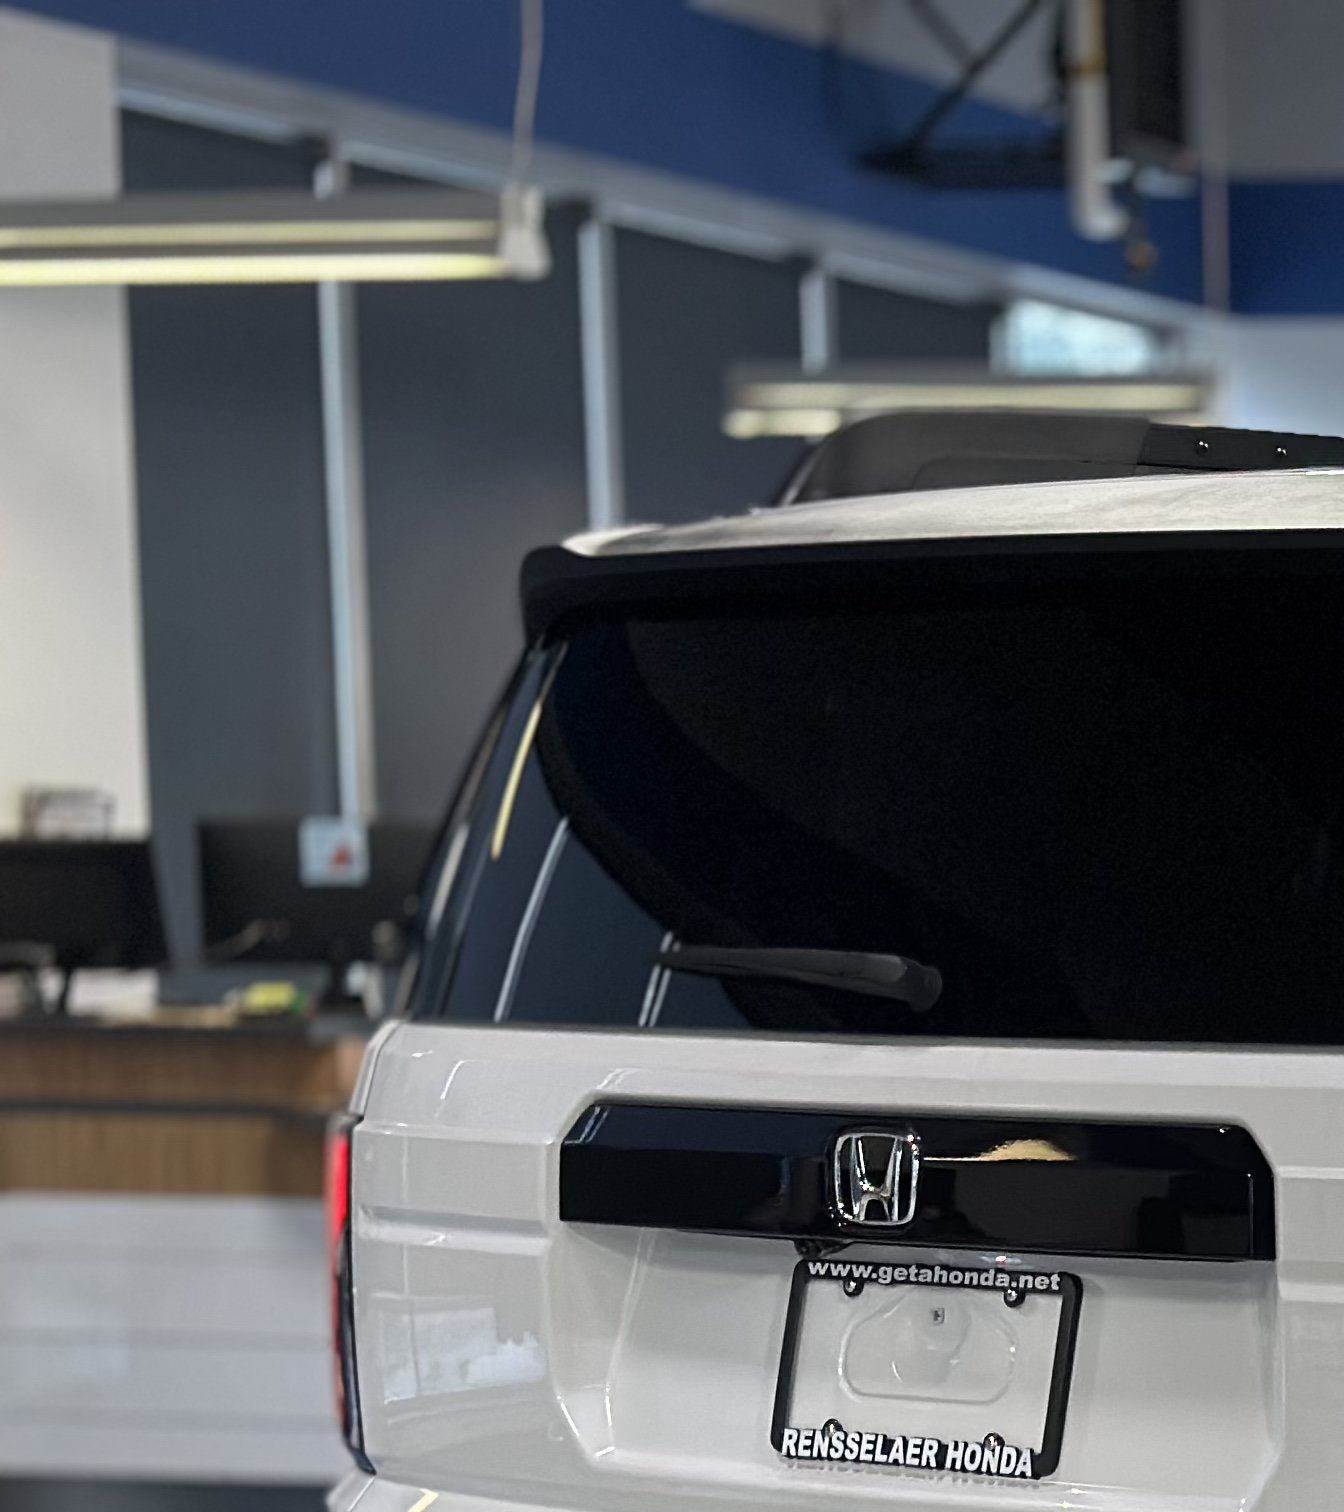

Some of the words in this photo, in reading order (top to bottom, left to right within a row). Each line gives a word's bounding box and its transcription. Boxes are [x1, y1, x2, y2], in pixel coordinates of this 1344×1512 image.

[807, 1260, 1061, 1292] www.getahonda.net
[781, 1428, 938, 1468] RENSSELAER
[945, 1440, 1032, 1478] HONDA
